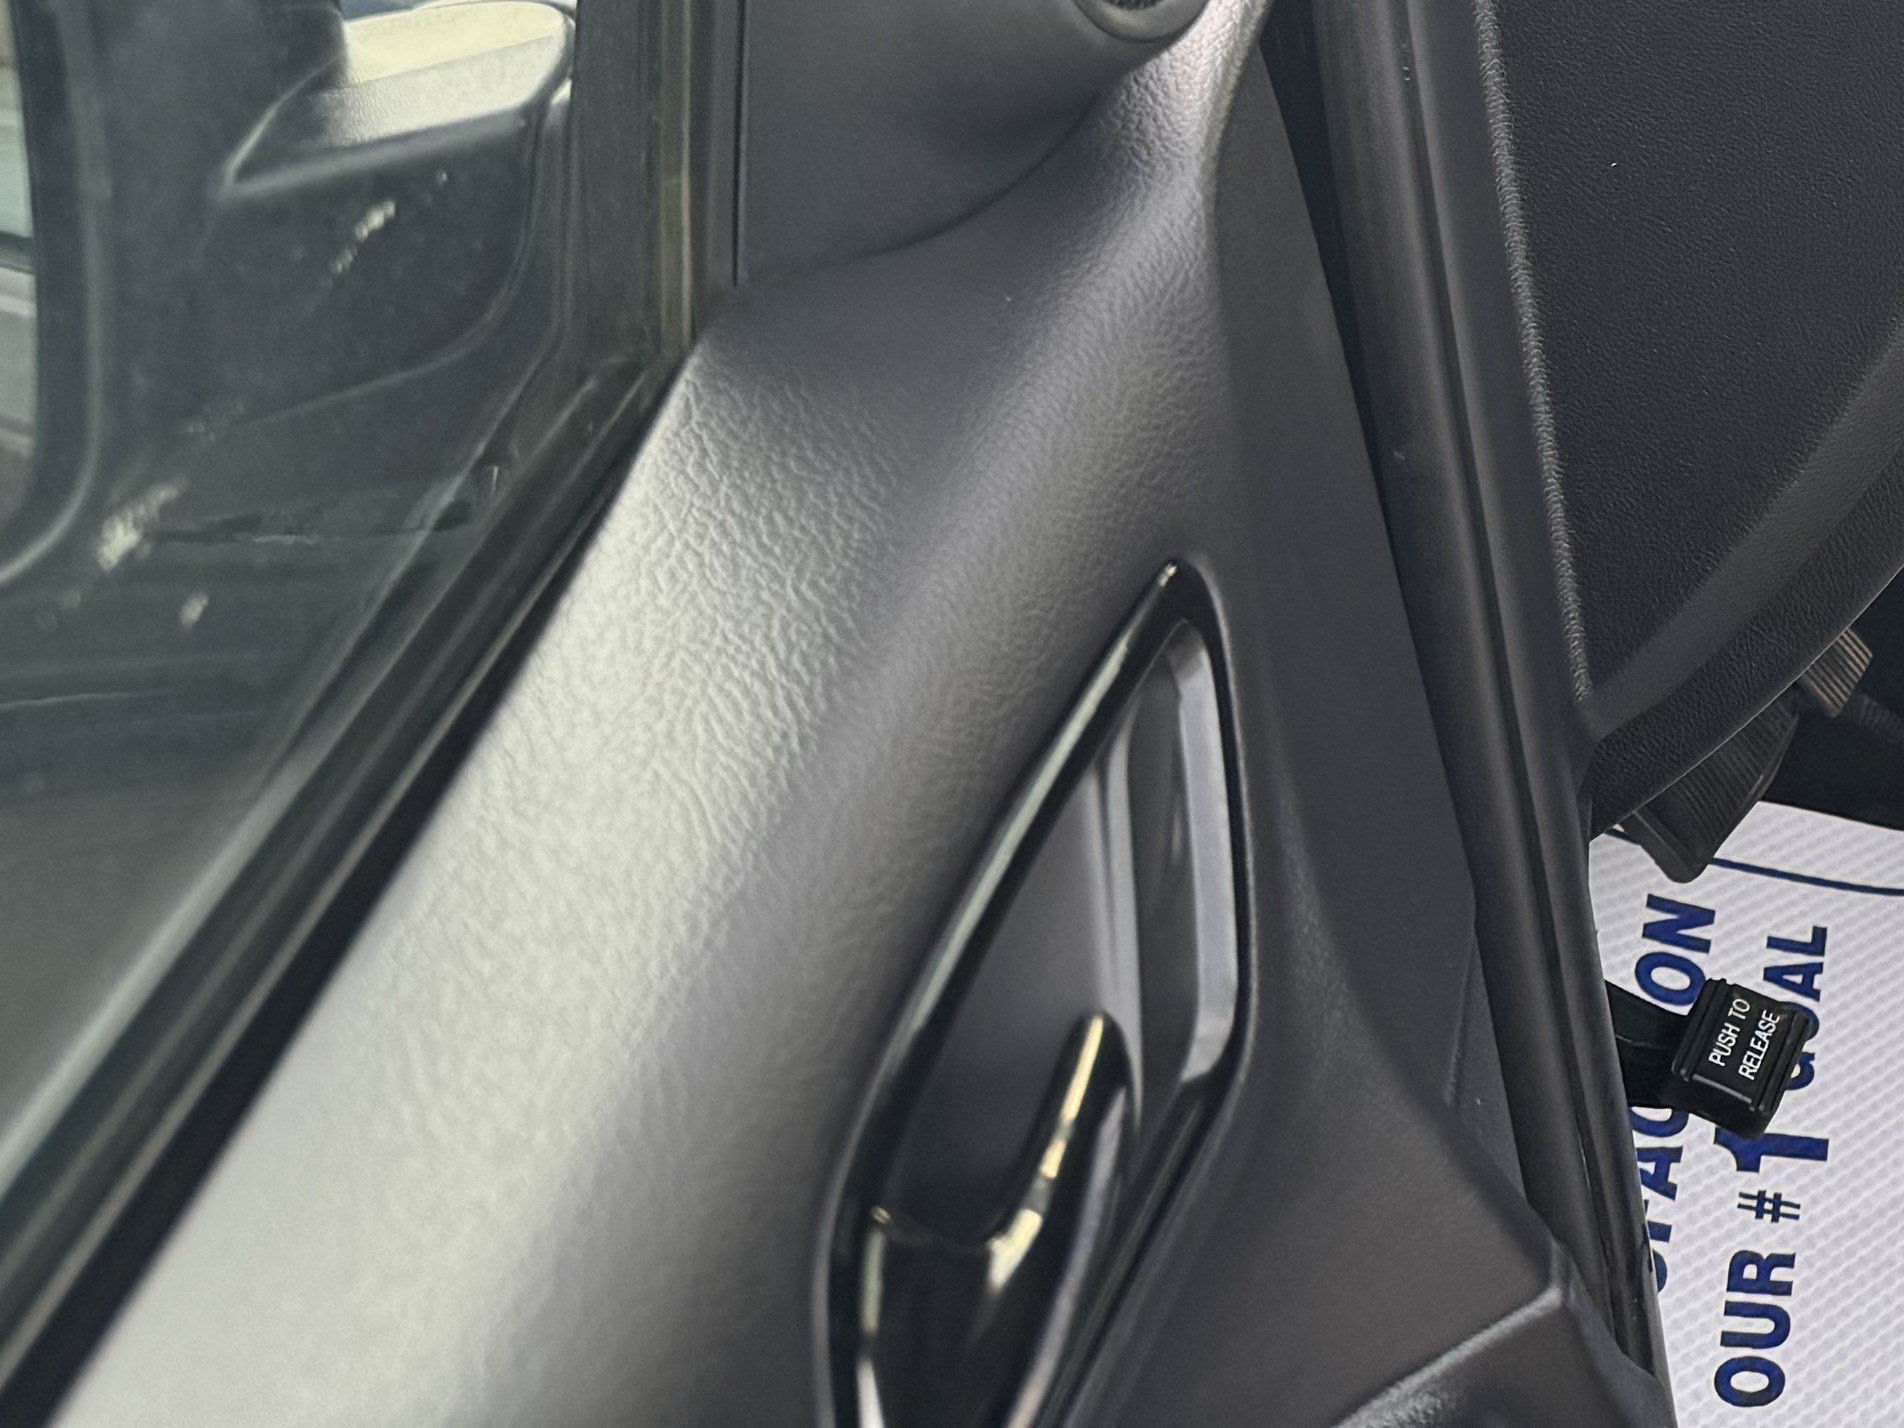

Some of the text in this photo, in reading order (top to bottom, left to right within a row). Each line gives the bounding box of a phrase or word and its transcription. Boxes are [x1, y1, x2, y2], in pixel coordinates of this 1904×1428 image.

[1708, 998, 1751, 1067] PUSH TO
[1738, 1009, 1780, 1081] RELEASE
[1713, 1249, 1797, 1408] OUR
